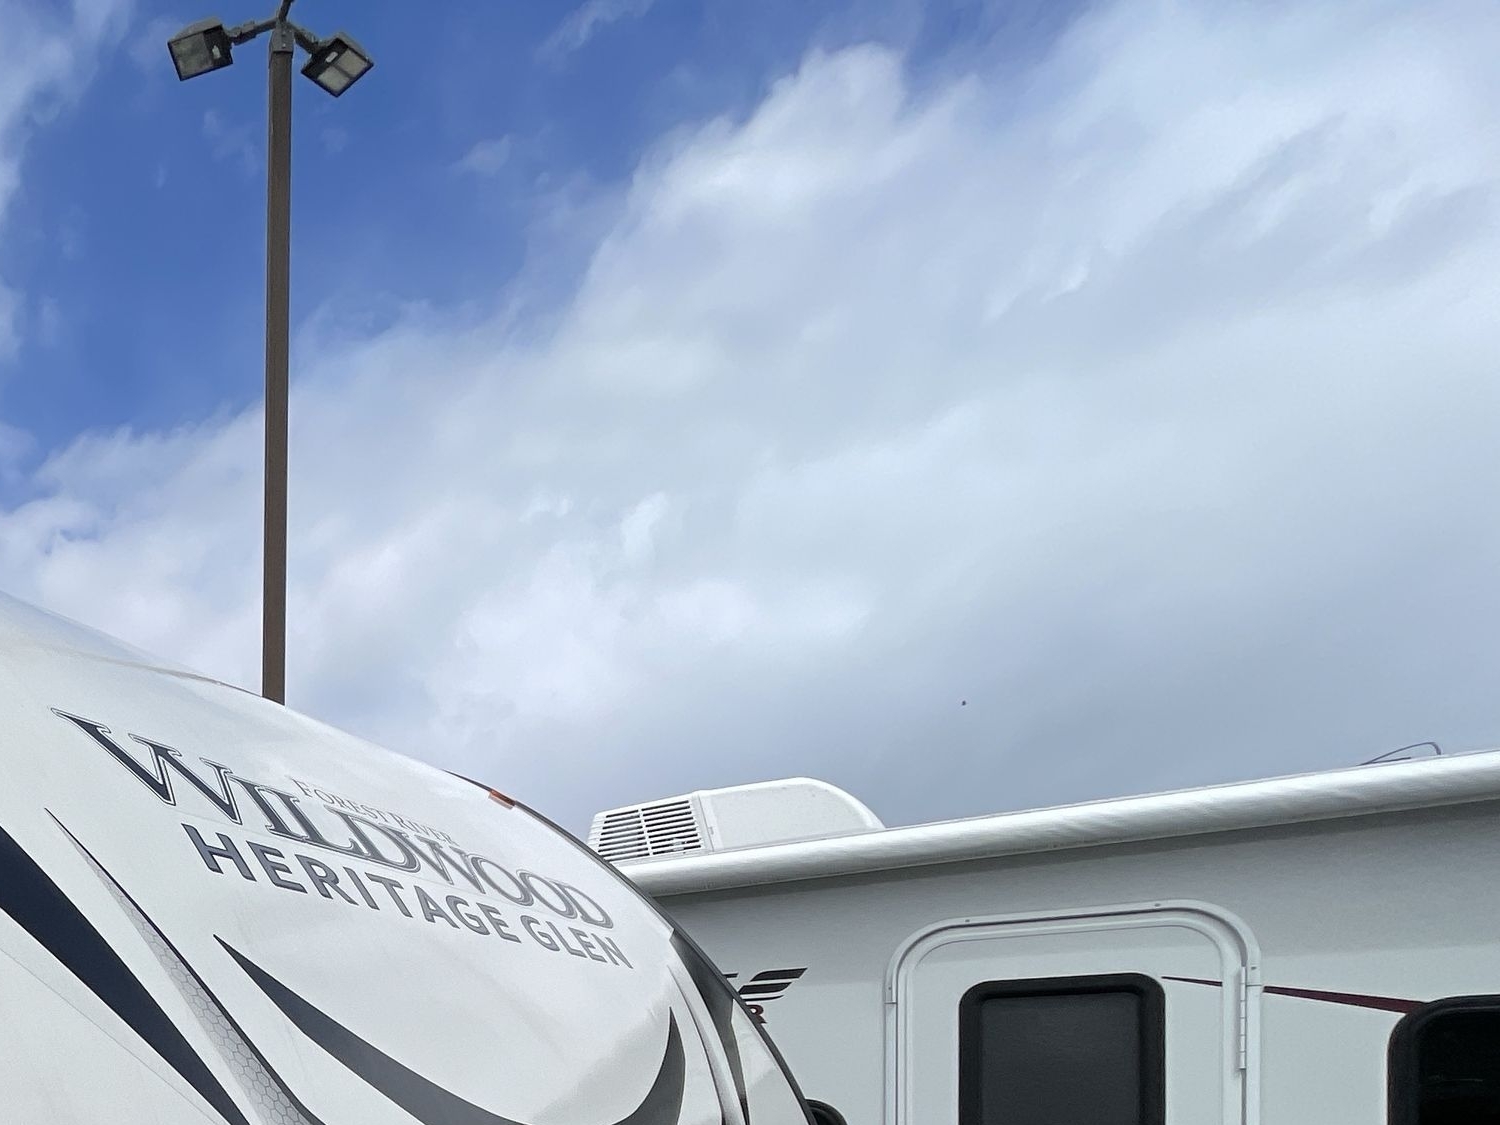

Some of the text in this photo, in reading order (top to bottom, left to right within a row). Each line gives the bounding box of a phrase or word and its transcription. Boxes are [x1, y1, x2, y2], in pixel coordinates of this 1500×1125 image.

[51, 707, 615, 929] WILDWOOD
[285, 774, 460, 847] FOREST RIVER
[181, 822, 634, 970] HERITAGE GLEN
